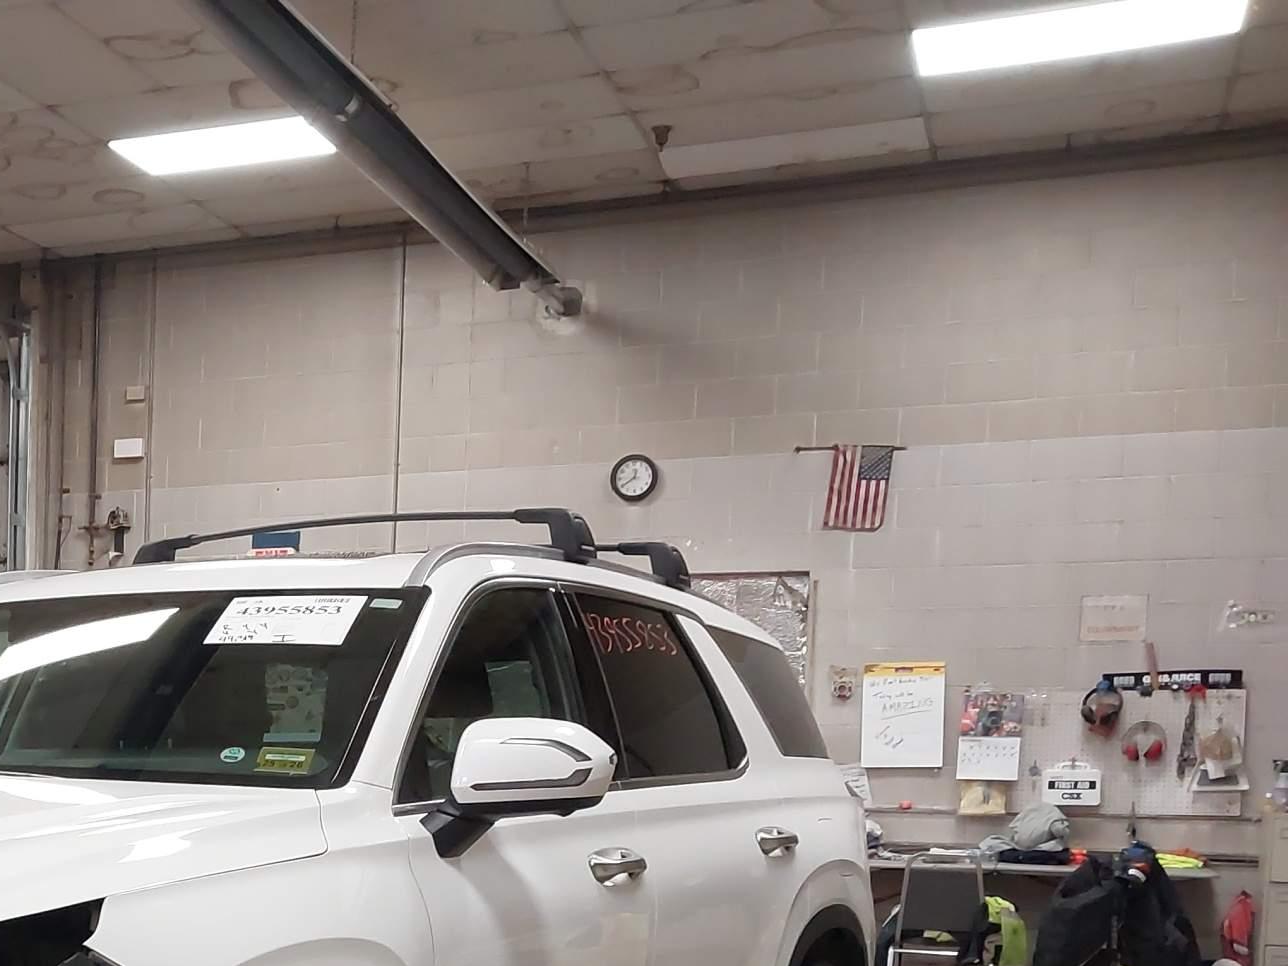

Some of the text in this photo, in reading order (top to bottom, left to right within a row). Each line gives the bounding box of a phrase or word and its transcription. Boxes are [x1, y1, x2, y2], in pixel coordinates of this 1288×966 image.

[236, 604, 343, 616] 43955853
[1054, 781, 1090, 789] FIRST AID
